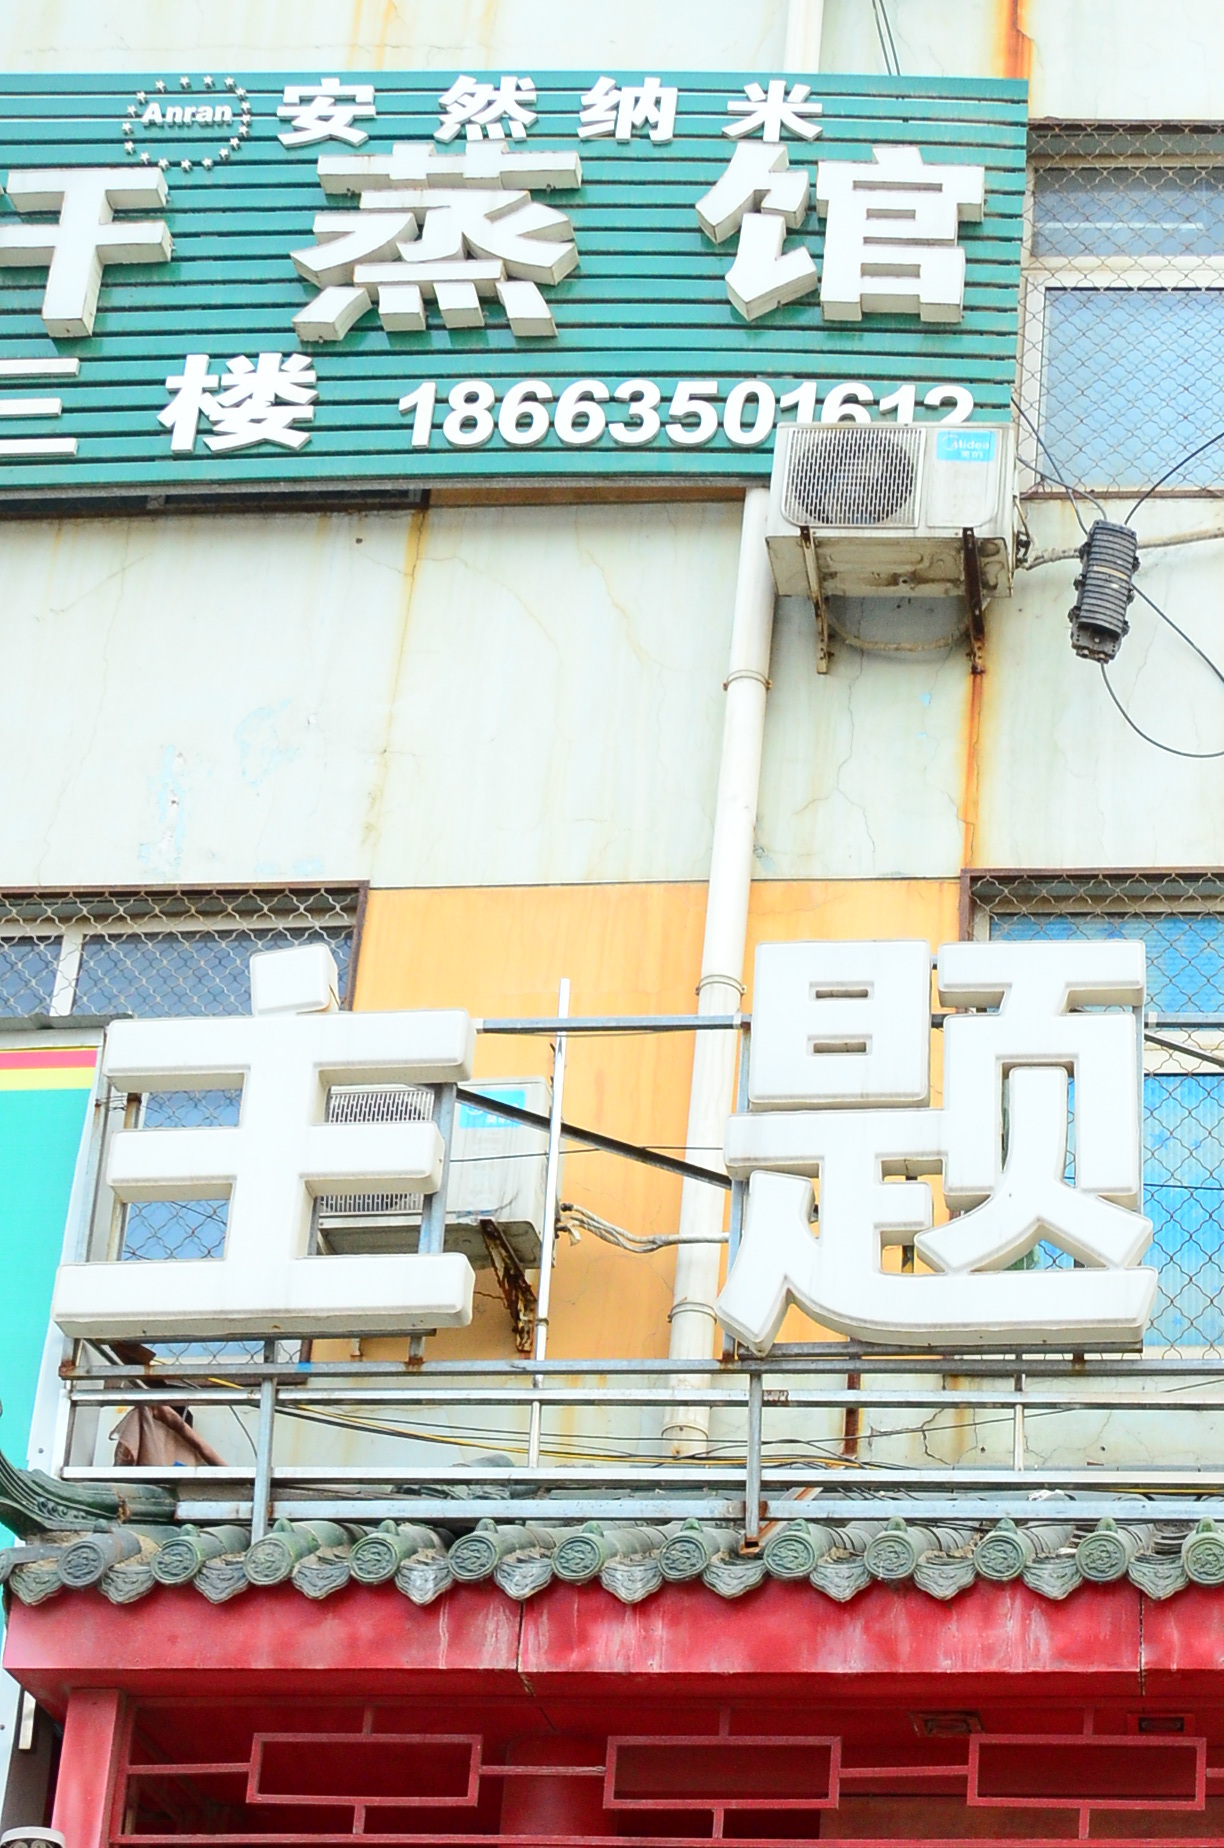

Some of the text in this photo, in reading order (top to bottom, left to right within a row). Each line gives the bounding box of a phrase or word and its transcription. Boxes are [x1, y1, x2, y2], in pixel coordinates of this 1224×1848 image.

[141, 101, 233, 128] Anran
[276, 75, 823, 147] 安然纳米
[398, 380, 974, 450] 18663501612
